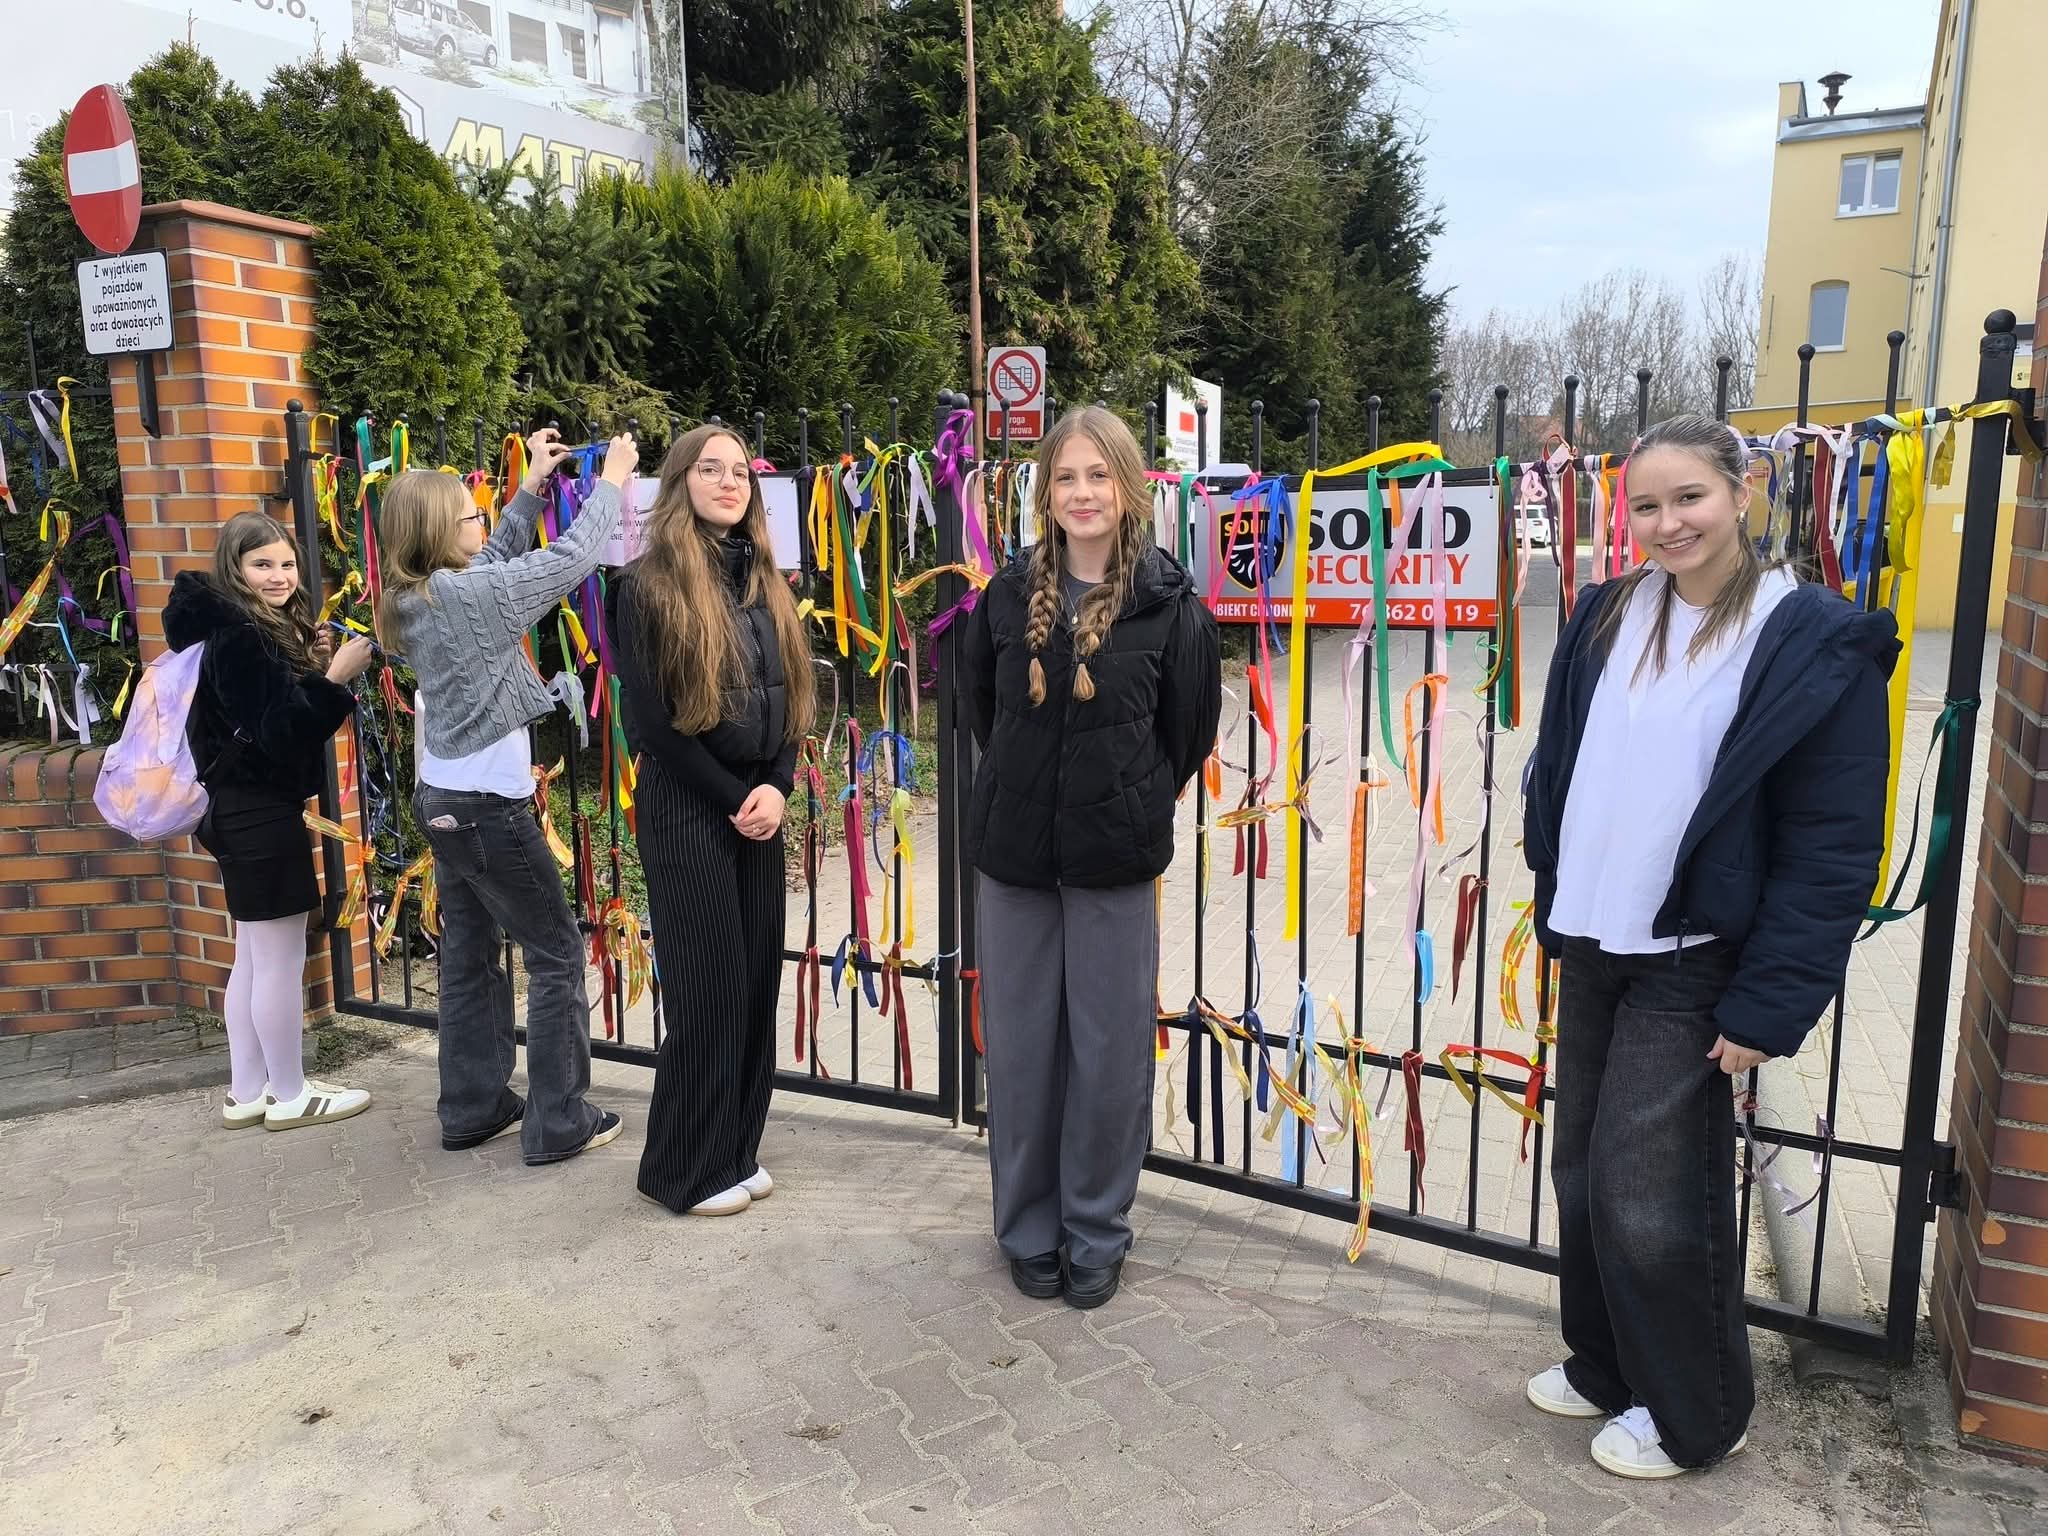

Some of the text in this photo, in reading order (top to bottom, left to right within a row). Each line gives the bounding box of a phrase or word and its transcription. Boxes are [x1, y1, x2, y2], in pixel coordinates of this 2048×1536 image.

[93, 259, 148, 280] Z wyjątkiem
[102, 277, 143, 299] pojazdów
[92, 295, 157, 317] upoważnionych
[90, 312, 164, 332] oraz dowożących
[115, 332, 141, 347] dzieci
[1008, 416, 1026, 426] roga
[996, 426, 1033, 437] parowa
[1212, 603, 1248, 617] BIEKT
[1250, 603, 1316, 618] CONIY
[1421, 604, 1447, 621] 0
[1453, 604, 1479, 622] 19
